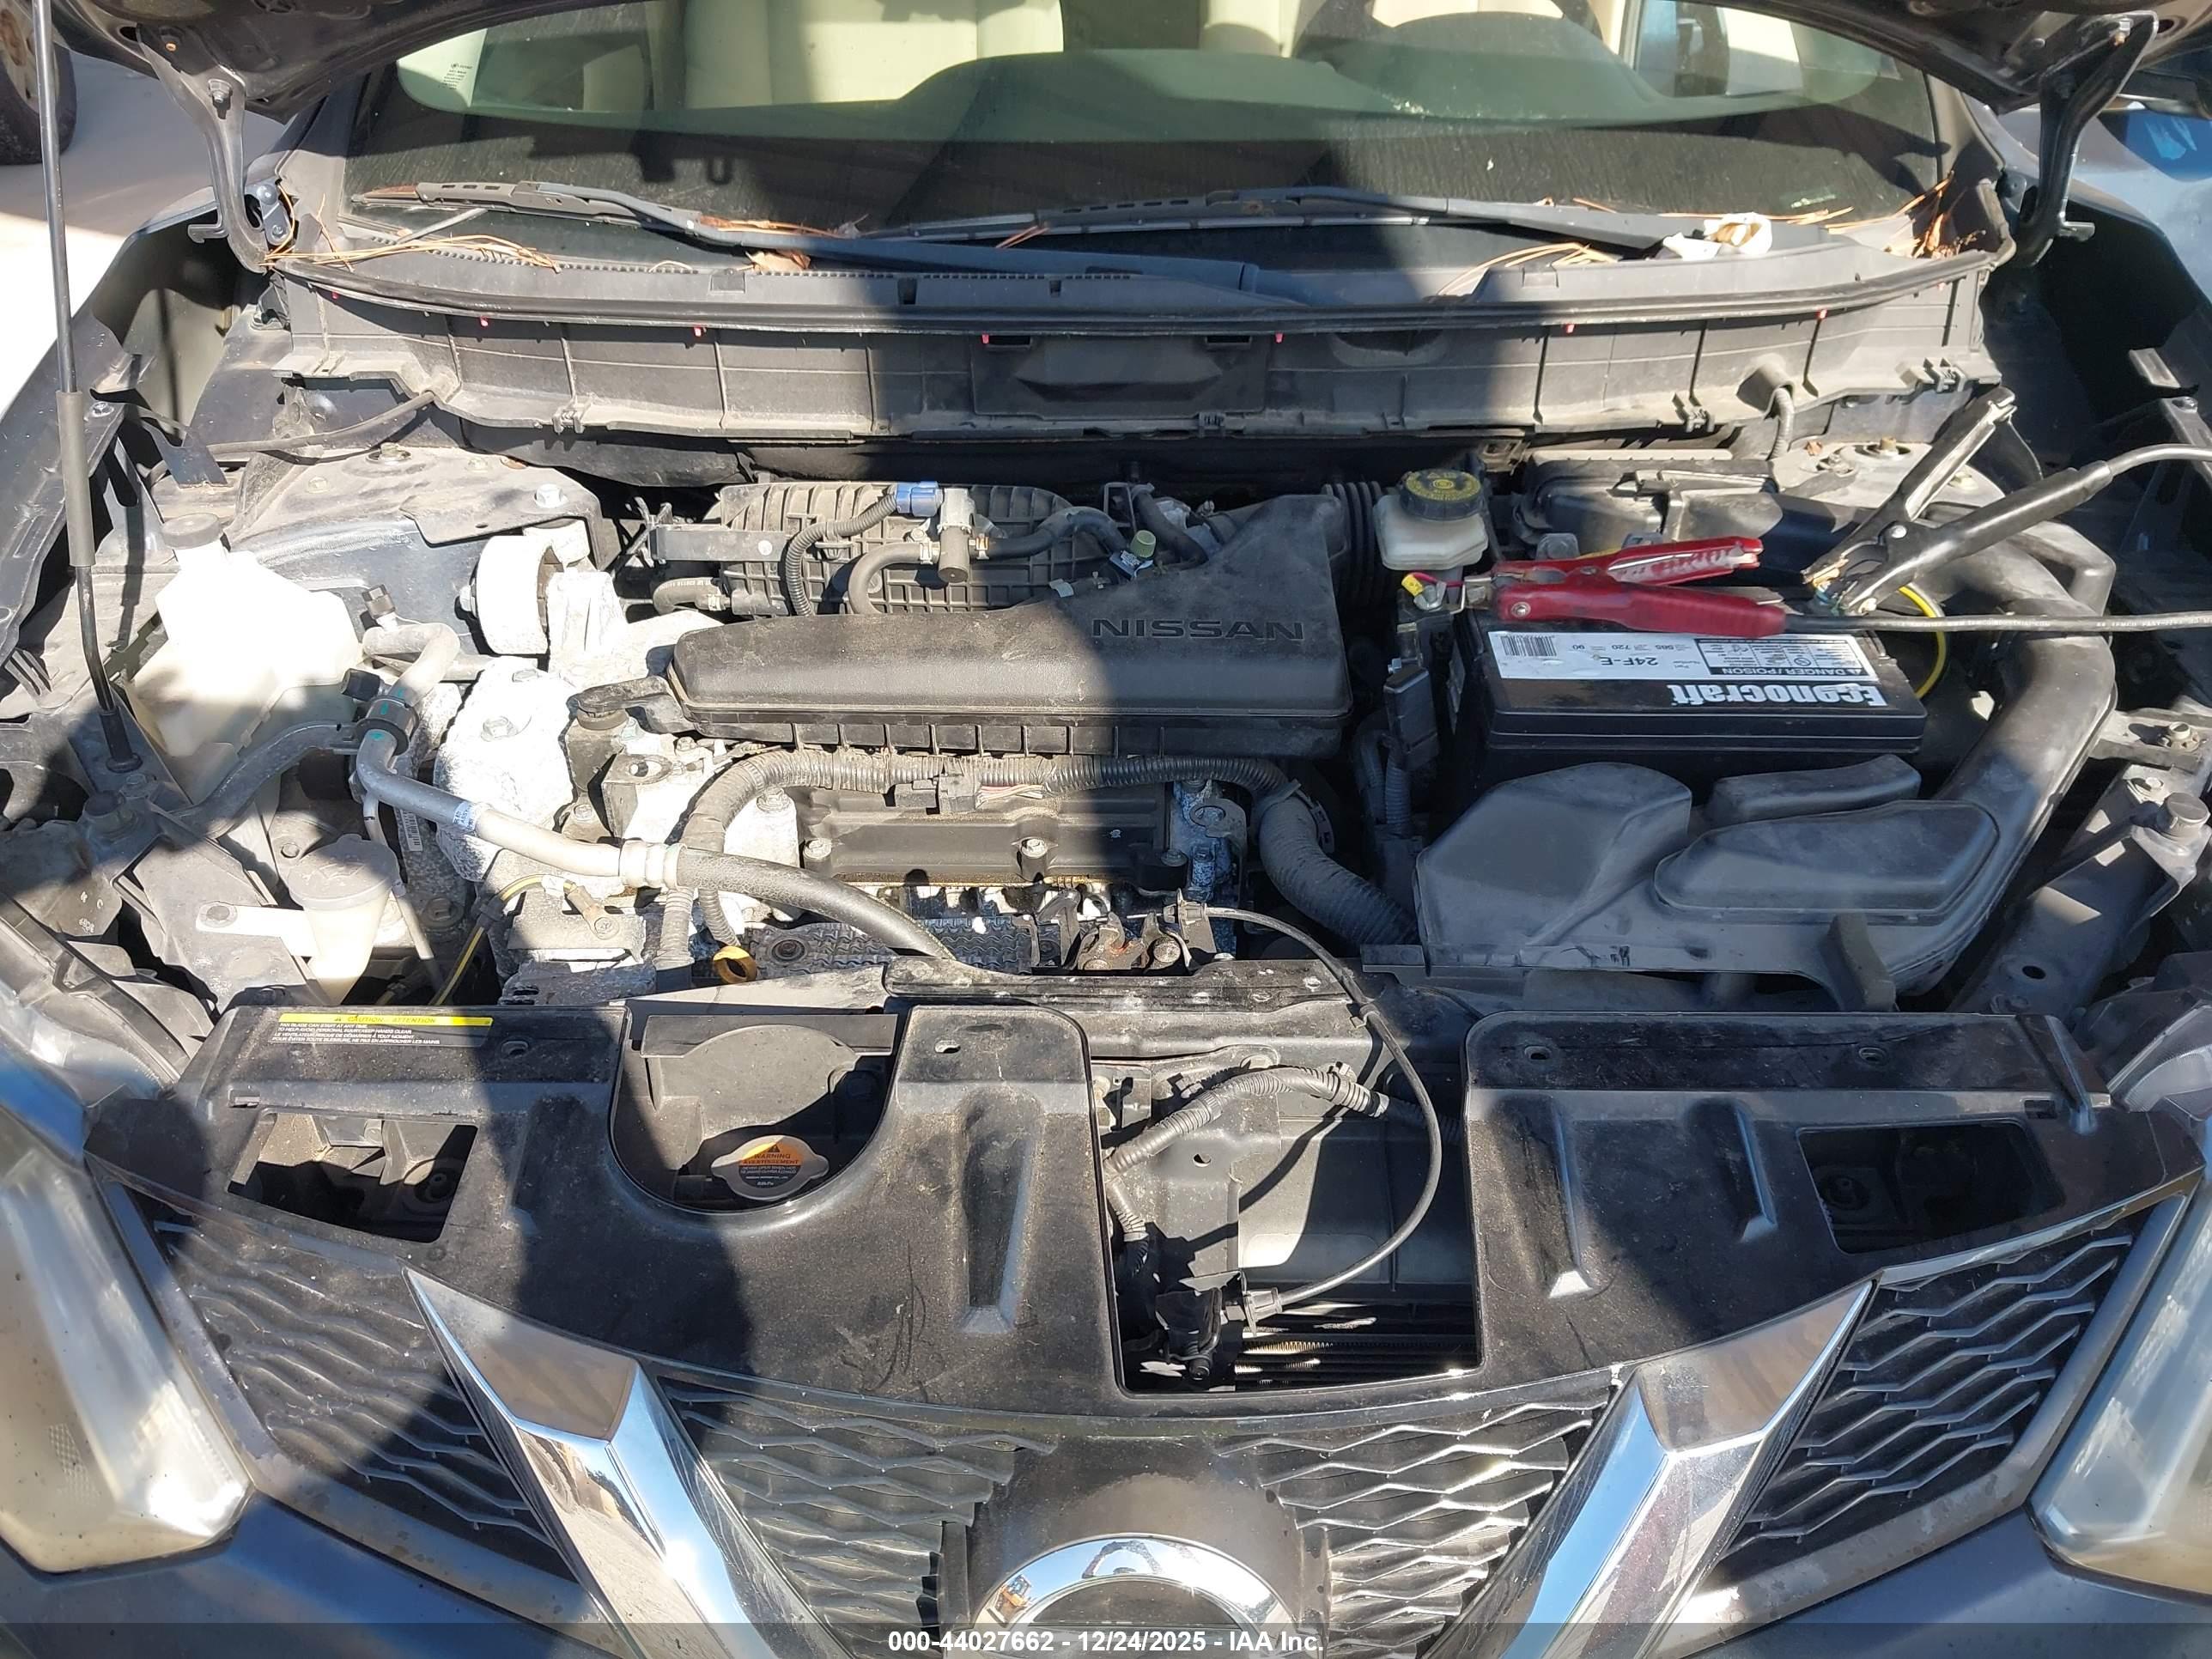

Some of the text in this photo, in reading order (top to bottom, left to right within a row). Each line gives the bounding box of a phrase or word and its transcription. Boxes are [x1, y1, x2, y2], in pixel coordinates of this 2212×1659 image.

[1092, 618, 1304, 640] NISSAN
[1601, 657, 1658, 666] 24F-E
[1667, 684, 1888, 707] Econocraft
